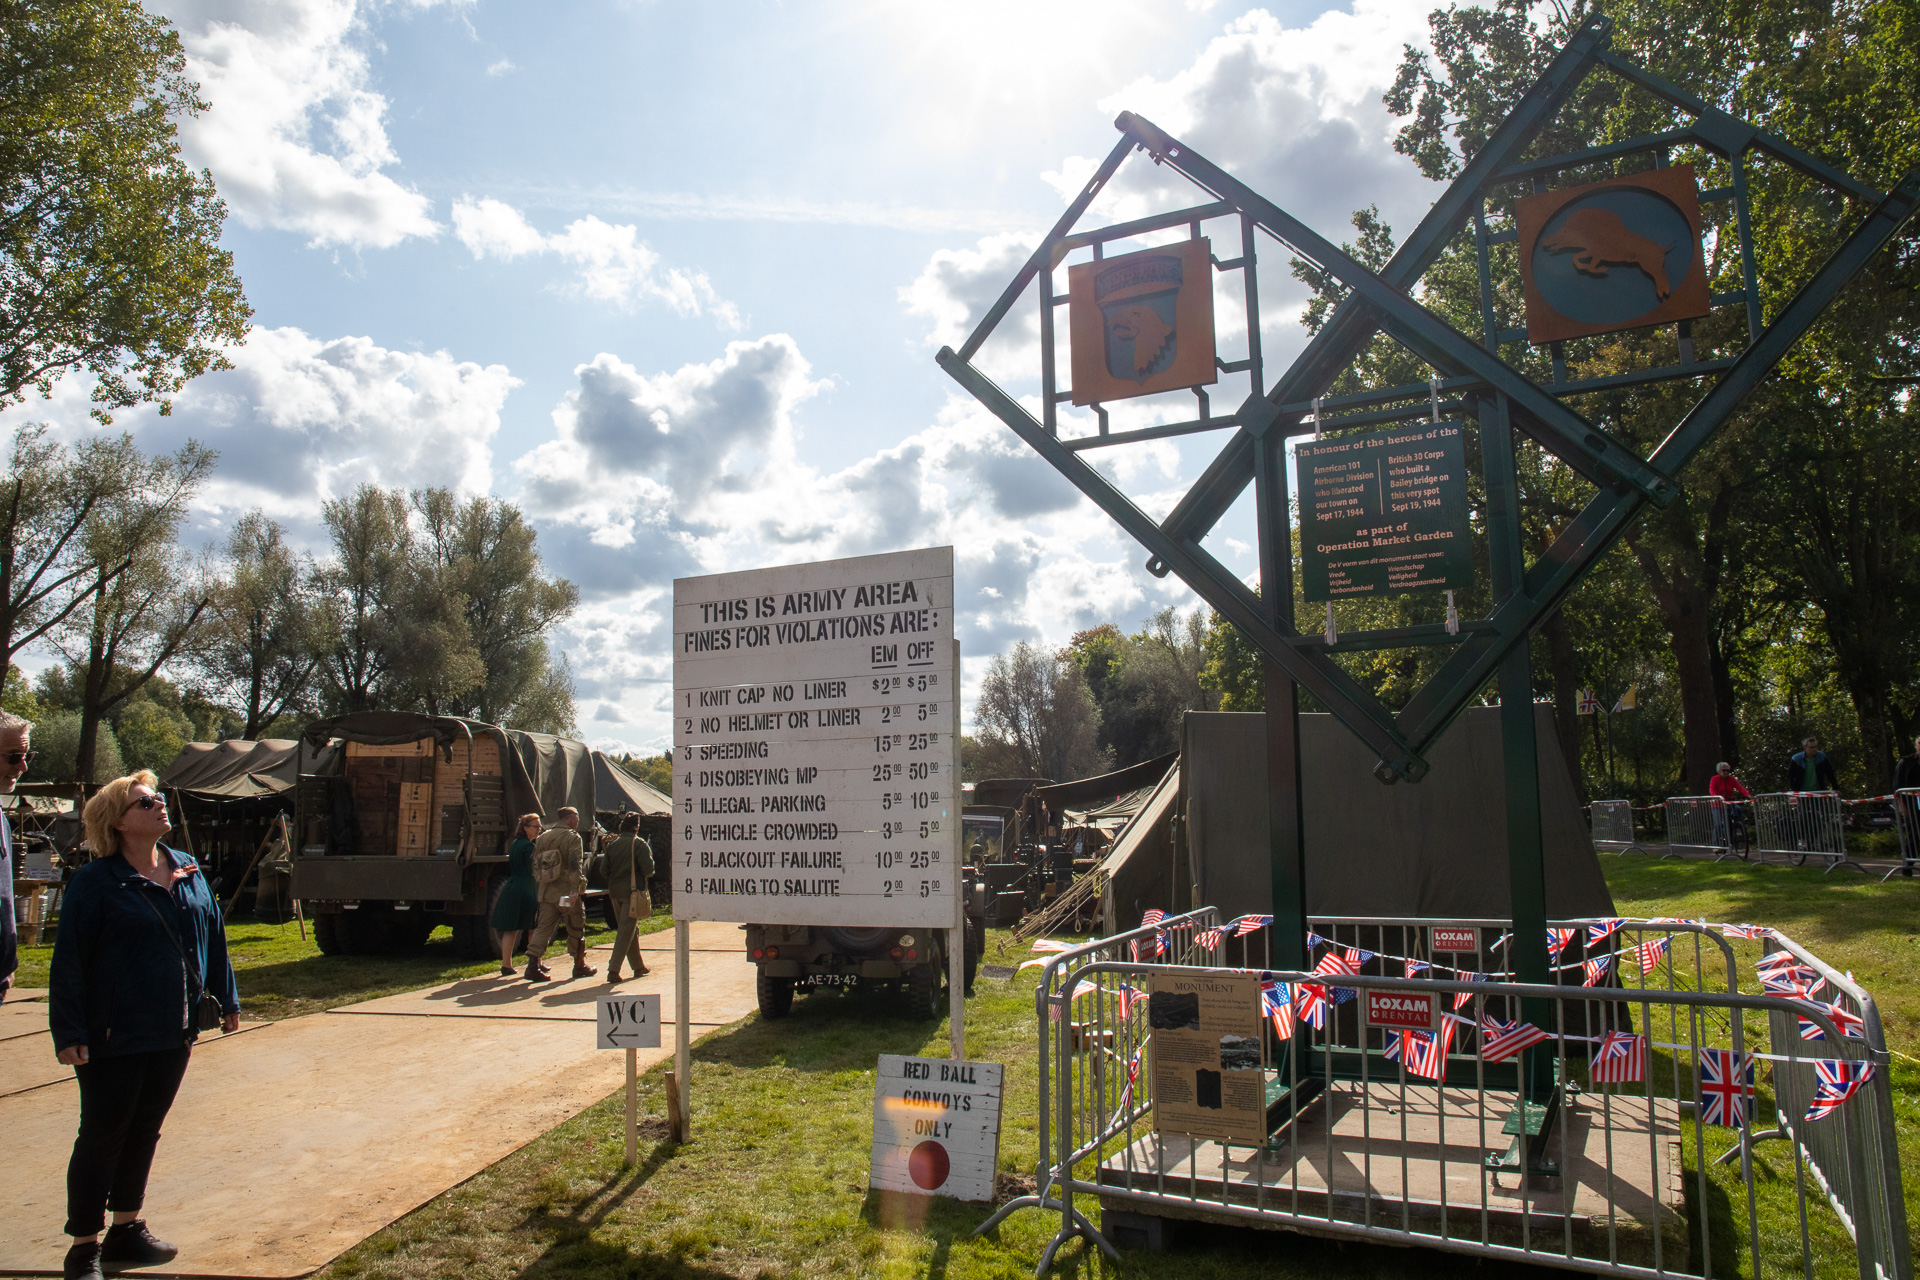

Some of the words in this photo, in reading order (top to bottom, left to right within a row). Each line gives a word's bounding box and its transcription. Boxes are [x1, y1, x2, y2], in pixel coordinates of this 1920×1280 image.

[1314, 445, 1350, 454] honour
[1354, 441, 1364, 449] of
[1367, 439, 1384, 448] the
[1388, 434, 1422, 444] heroes
[1427, 430, 1437, 438] of
[1440, 428, 1458, 436] the
[1389, 454, 1412, 464] British
[1424, 451, 1444, 461] Corps
[1314, 464, 1346, 474] American
[1348, 462, 1360, 470] 101
[1389, 468, 1405, 476] who
[1406, 465, 1424, 474] built
[1315, 475, 1344, 485] Airborne
[1346, 472, 1374, 482] Division
[1391, 479, 1412, 489] Bailey
[1414, 476, 1438, 486] bridge
[1315, 489, 1330, 497] who
[1332, 484, 1363, 495] liberated
[1391, 491, 1405, 500] this
[1407, 489, 1422, 499] very
[1424, 488, 1439, 497] spot
[1329, 499, 1347, 507] town
[1392, 502, 1408, 512] Sept
[1410, 501, 1422, 510] 19,
[1423, 499, 1441, 507] 1944
[1317, 512, 1332, 521] Sept
[1334, 510, 1344, 518] 17,
[1347, 508, 1364, 516] 1944
[1371, 525, 1393, 536] part
[1397, 523, 1408, 531] of
[1318, 540, 1369, 552] Operation
[1373, 535, 1410, 546] Market
[1414, 531, 1453, 541] Garden
[1379, 555, 1411, 563] monument
[1388, 564, 1424, 572] Vriendschap
[1389, 572, 1417, 580] Veiligheid
[1389, 577, 1445, 588] Verdraagzaamheid
[1330, 584, 1373, 594] Verbondenheid
[701, 599, 748, 623] THIS
[756, 596, 775, 618] IS
[782, 588, 846, 616] ARMY
[854, 581, 918, 608] AREA
[685, 628, 731, 653] FINES
[736, 625, 769, 648] FOR
[776, 613, 885, 643] VIOLATIONS
[890, 609, 938, 634] ARE:
[871, 644, 897, 663] EM
[908, 641, 934, 660] OFF
[685, 693, 691, 708] 1
[700, 690, 731, 707] KNIT
[738, 687, 765, 704] CAP
[773, 685, 794, 702] NO
[805, 681, 846, 700] LINER
[685, 719, 692, 734] 2
[701, 717, 720, 733] NO
[729, 713, 783, 731] HELMET
[788, 711, 809, 728] OR
[818, 708, 861, 726] LINER
[685, 745, 692, 760] 3
[700, 741, 768, 760] SPEEDING
[685, 772, 692, 787] 4
[700, 768, 788, 787] DISOBEYING
[797, 767, 817, 784] MP
[685, 798, 692, 814] 5
[700, 797, 754, 814] ILLEGAL
[762, 794, 826, 812] PARKING
[685, 825, 692, 840] 6
[700, 824, 757, 841] VEHICLE
[764, 823, 838, 840] CROWDED
[685, 852, 692, 867] 7
[701, 852, 775, 869] BLACKOUT
[781, 852, 842, 868] FAILURE
[685, 878, 692, 893] 8
[700, 879, 756, 895] FAILING
[760, 879, 780, 896] TO
[784, 880, 840, 896] SALUTE
[1435, 932, 1473, 941] LOXAM
[1175, 983, 1235, 993] MONUMENT
[1371, 997, 1428, 1012] LOXAM
[1382, 1012, 1428, 1022] RENTAL
[904, 1062, 929, 1080] RED
[941, 1065, 976, 1084] BALL
[904, 1090, 971, 1111] CONVOYS
[915, 1119, 952, 1138] ONLY
